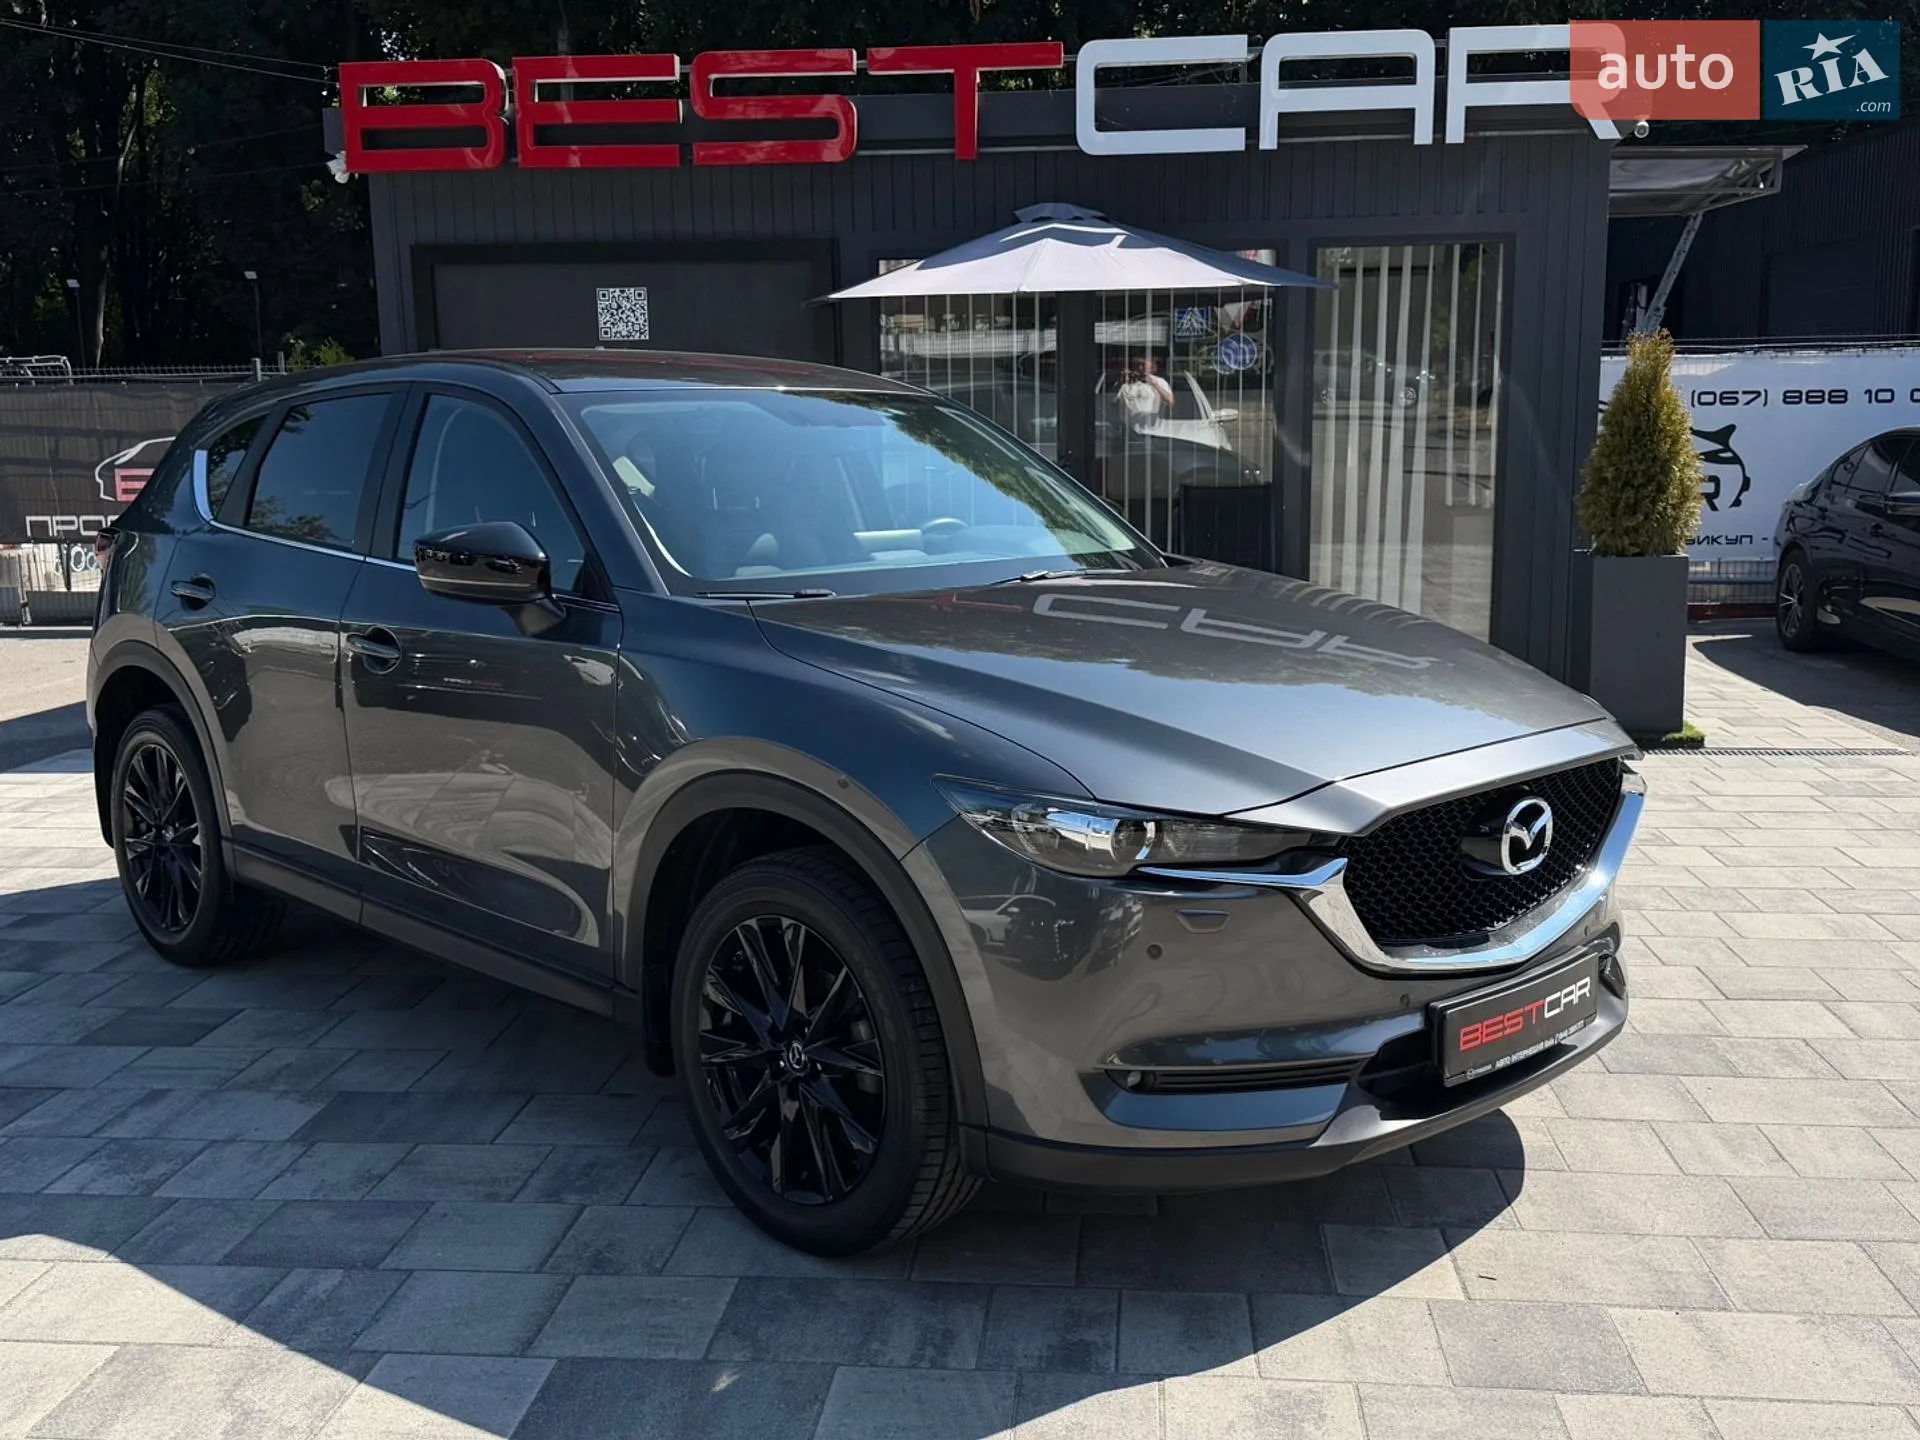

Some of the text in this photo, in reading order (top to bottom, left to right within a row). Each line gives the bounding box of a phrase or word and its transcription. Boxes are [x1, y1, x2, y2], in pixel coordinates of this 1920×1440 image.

[1691, 388, 1768, 408] (067)
[1782, 389, 1849, 405] 888
[1864, 388, 1895, 404] 10
[25, 515, 120, 538] ПРО
[1459, 976, 1591, 1051] BESTCAR
